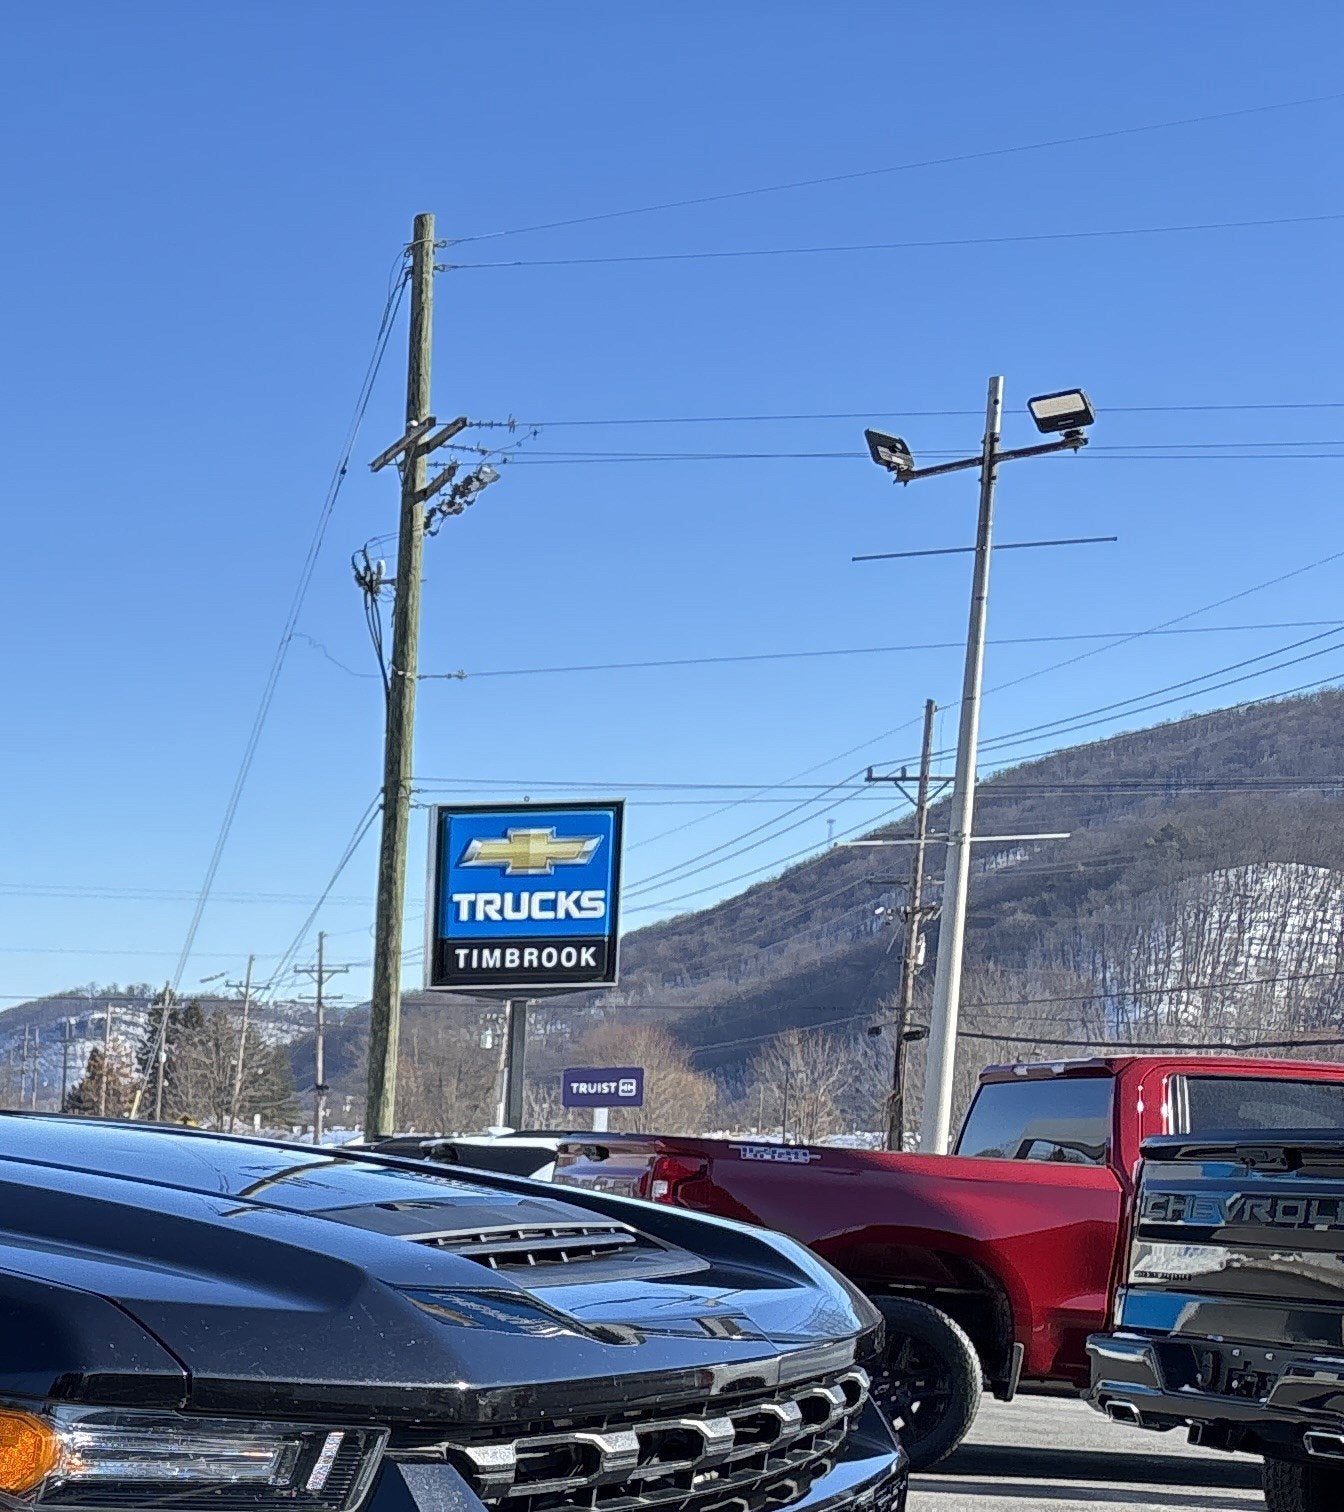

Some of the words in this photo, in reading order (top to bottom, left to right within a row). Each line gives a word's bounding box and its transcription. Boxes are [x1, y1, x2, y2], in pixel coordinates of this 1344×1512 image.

[451, 889, 607, 922] TRUCKS
[454, 946, 598, 970] TIMBROOK
[570, 1082, 618, 1094] TRUIST
[1144, 1193, 1344, 1226] CHEVROL
